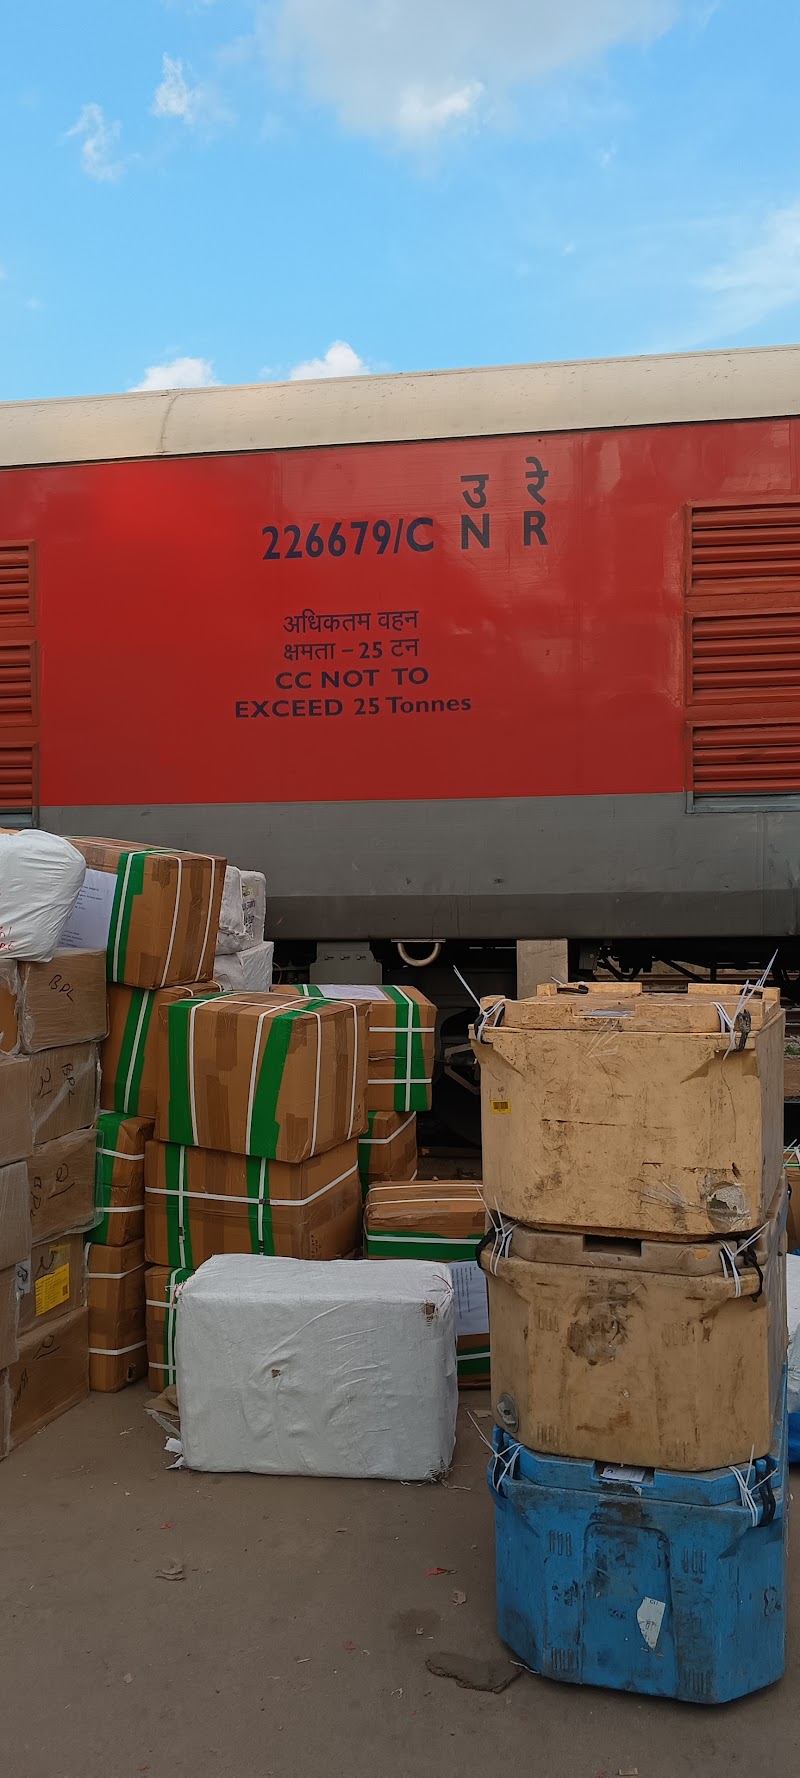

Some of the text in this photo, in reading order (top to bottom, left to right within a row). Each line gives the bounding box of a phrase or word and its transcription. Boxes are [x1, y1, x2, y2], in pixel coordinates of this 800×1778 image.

[460, 456, 549, 510] उ रे
[262, 510, 548, 560] 226679/C N R
[283, 608, 420, 634] अधिकतम वहन
[283, 643, 336, 662] क्षमता
[358, 641, 383, 659] 25
[389, 638, 420, 658] टन
[275, 667, 429, 690] CC NOT TO
[235, 696, 472, 719] EXCEED 25 Tonnes
